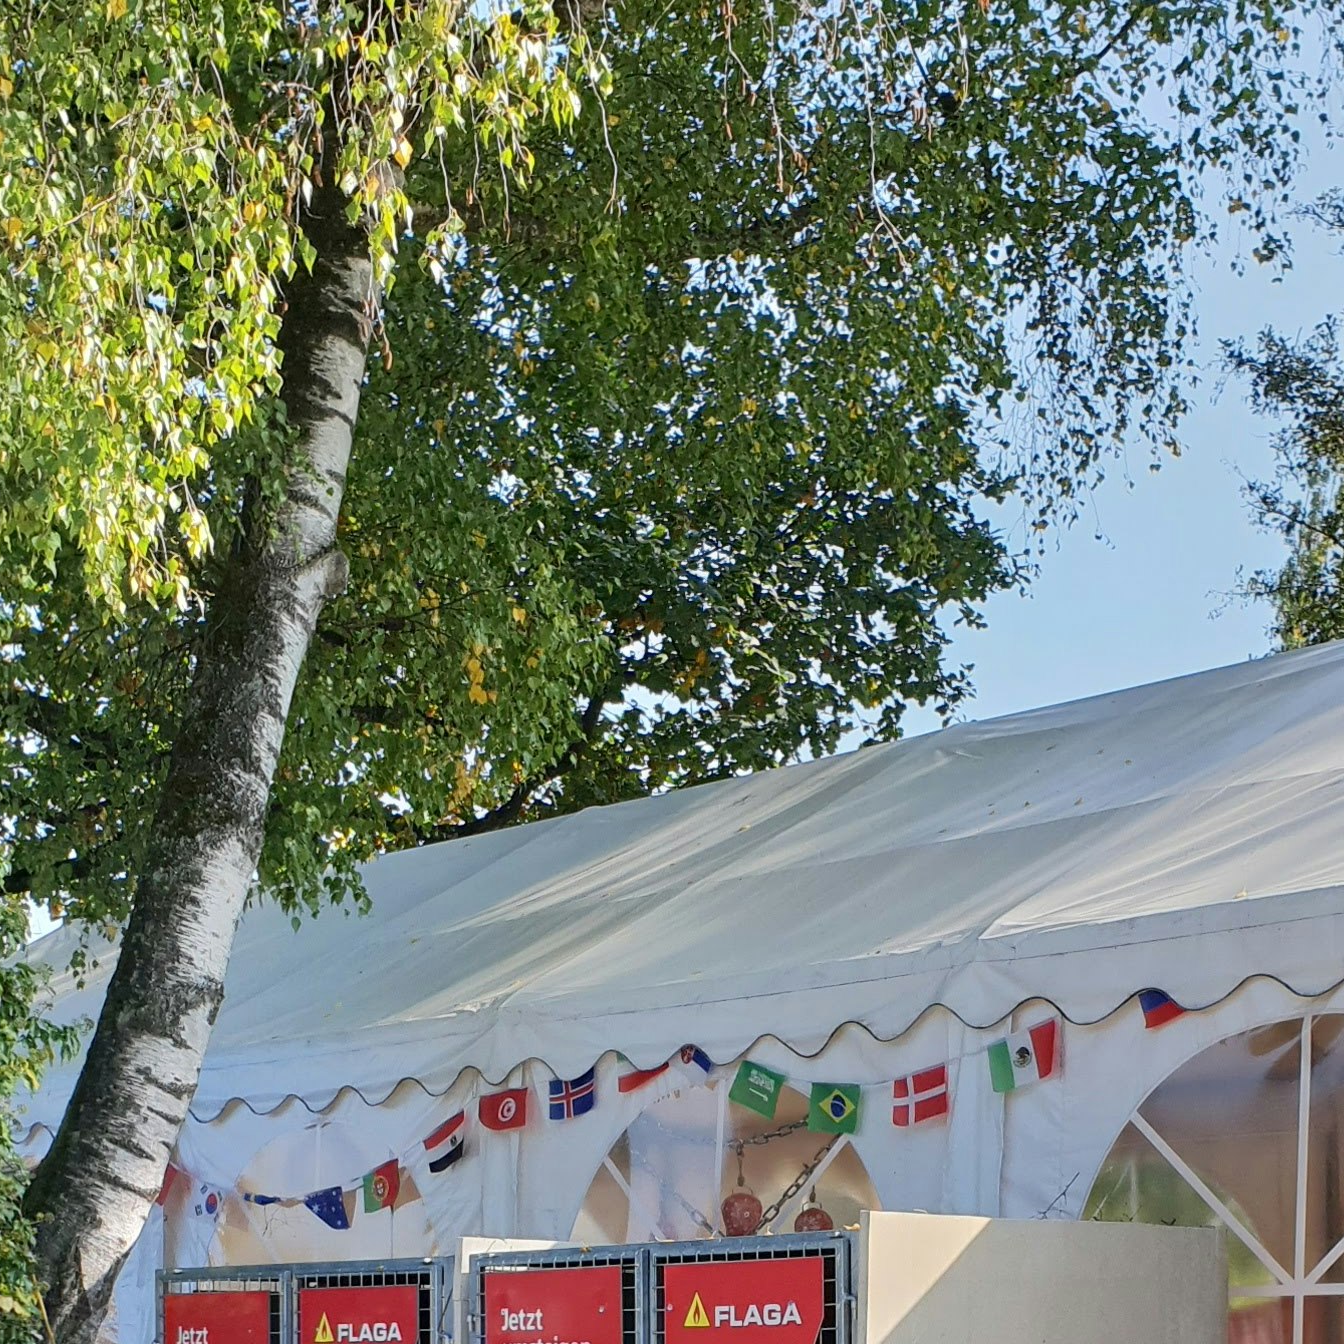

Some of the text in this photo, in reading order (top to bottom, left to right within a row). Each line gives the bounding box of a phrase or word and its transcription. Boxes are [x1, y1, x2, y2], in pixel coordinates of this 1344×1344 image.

[500, 1308, 543, 1332] Jetzt
[714, 1302, 802, 1328] FLAGA
[337, 1321, 402, 1343] FLAGA
